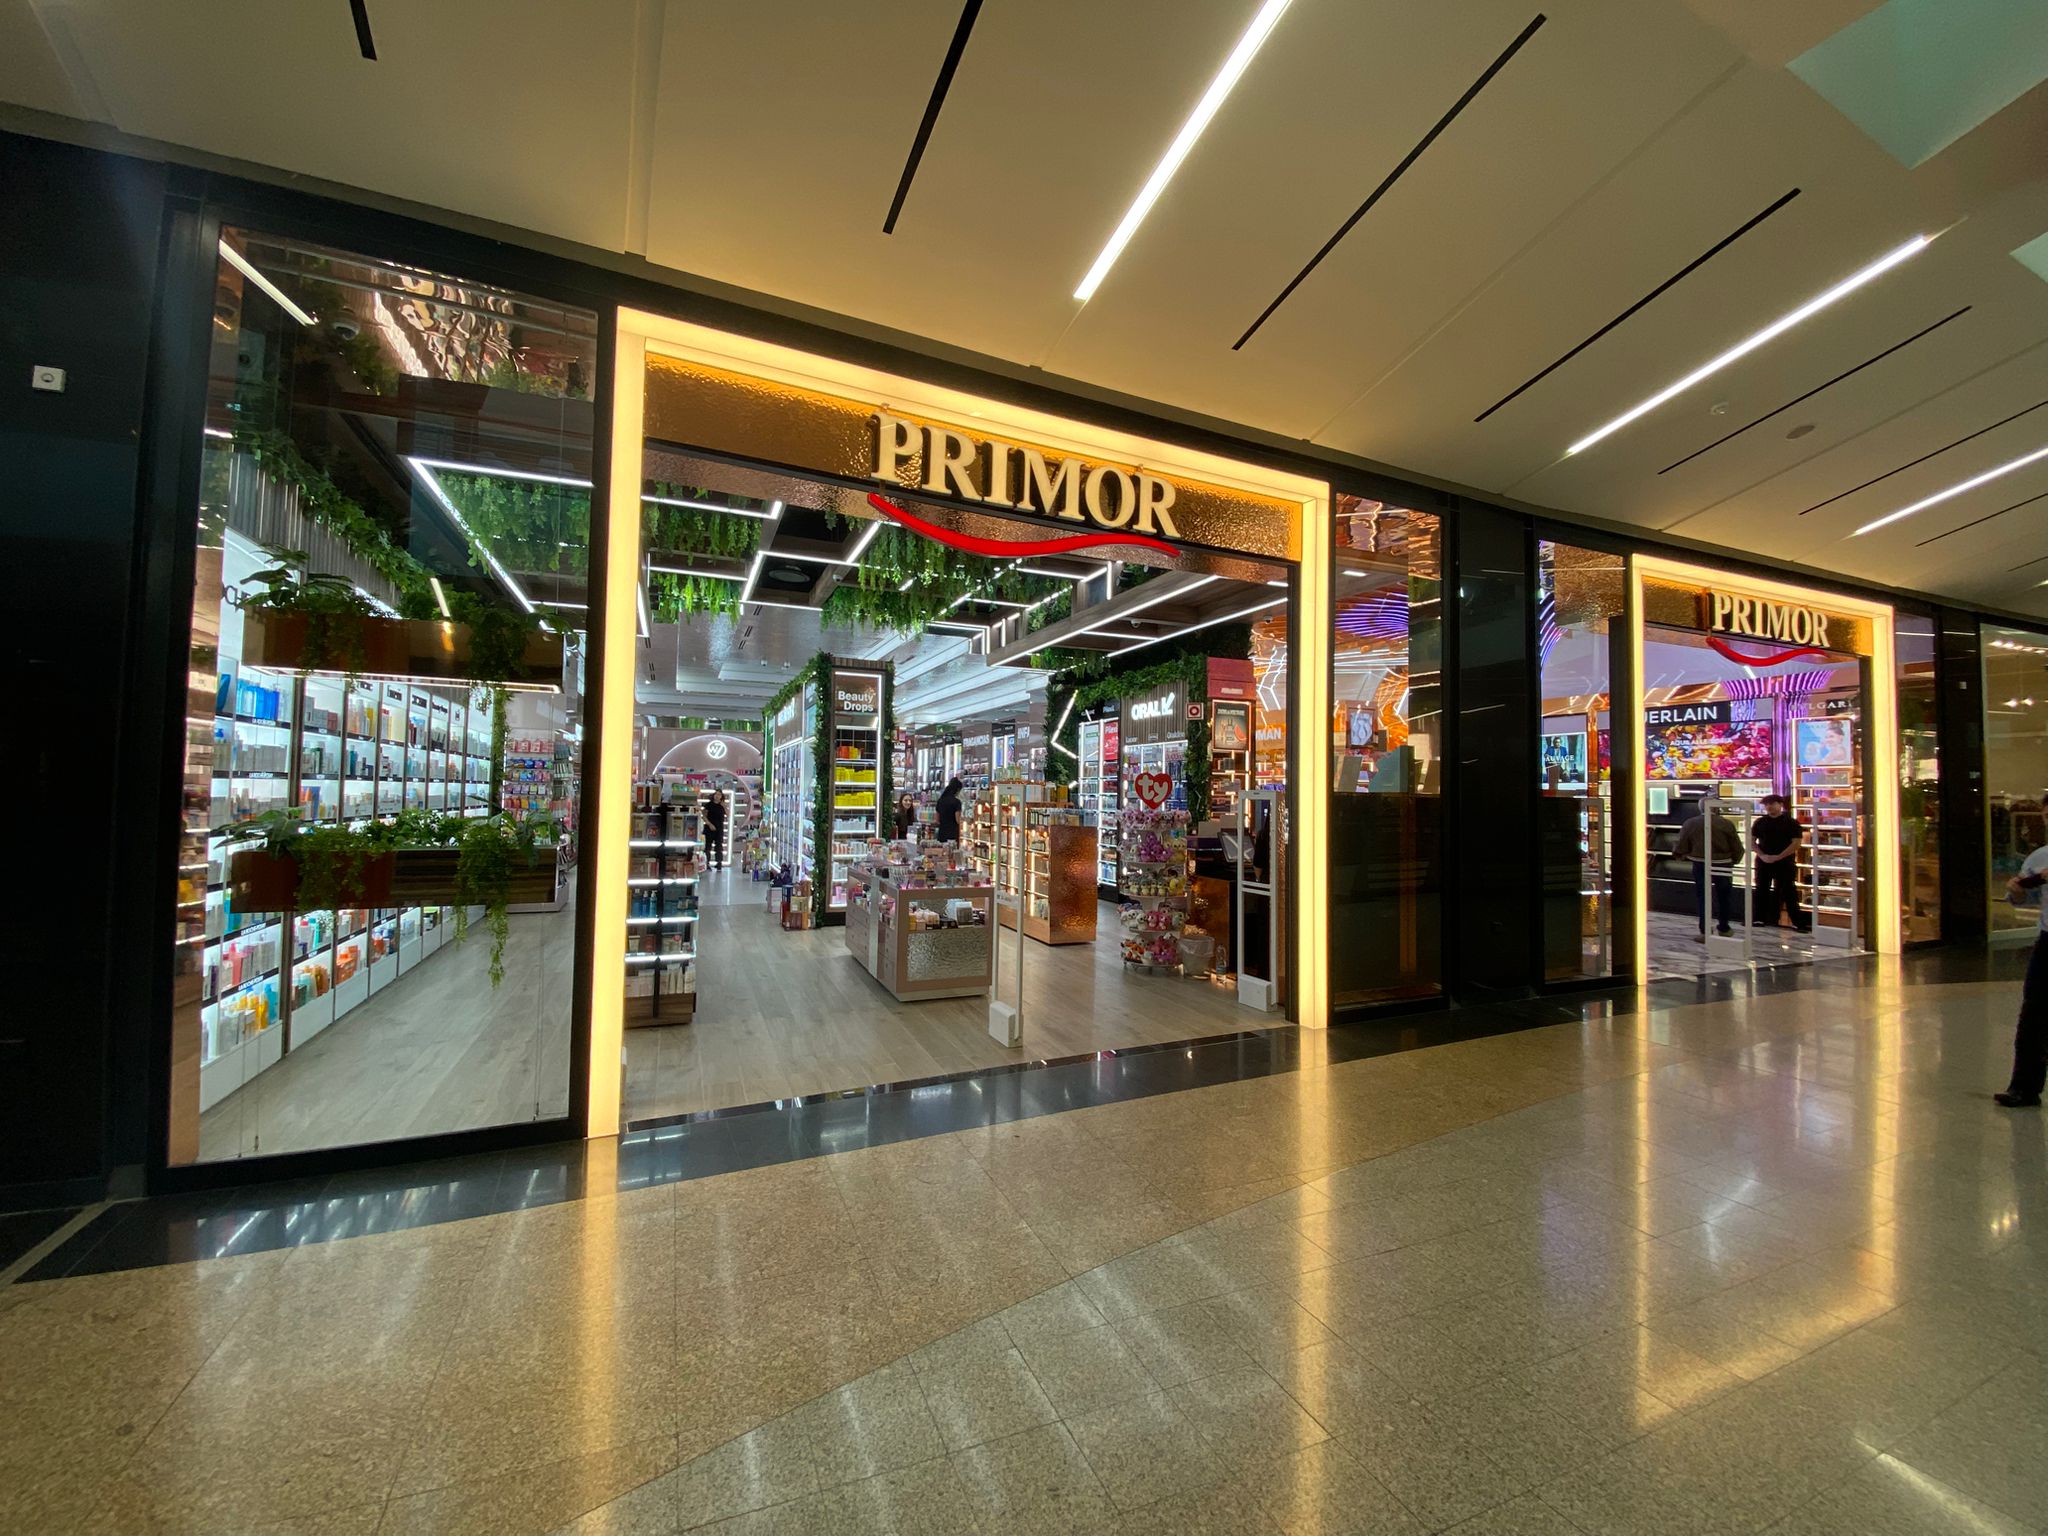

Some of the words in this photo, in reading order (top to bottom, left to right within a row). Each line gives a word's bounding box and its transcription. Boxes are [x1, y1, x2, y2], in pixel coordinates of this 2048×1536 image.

[871, 413, 1182, 538] PRIMOR
[1712, 591, 1831, 648] PRIMOR
[838, 691, 874, 704] Beauty
[844, 701, 874, 713] Drops
[1793, 700, 1853, 711] LGARI
[1131, 701, 1161, 720] ORAL
[1644, 705, 1718, 724] ERLAIN
[1543, 754, 1575, 763] AUVAGE
[1138, 774, 1169, 803] ty
